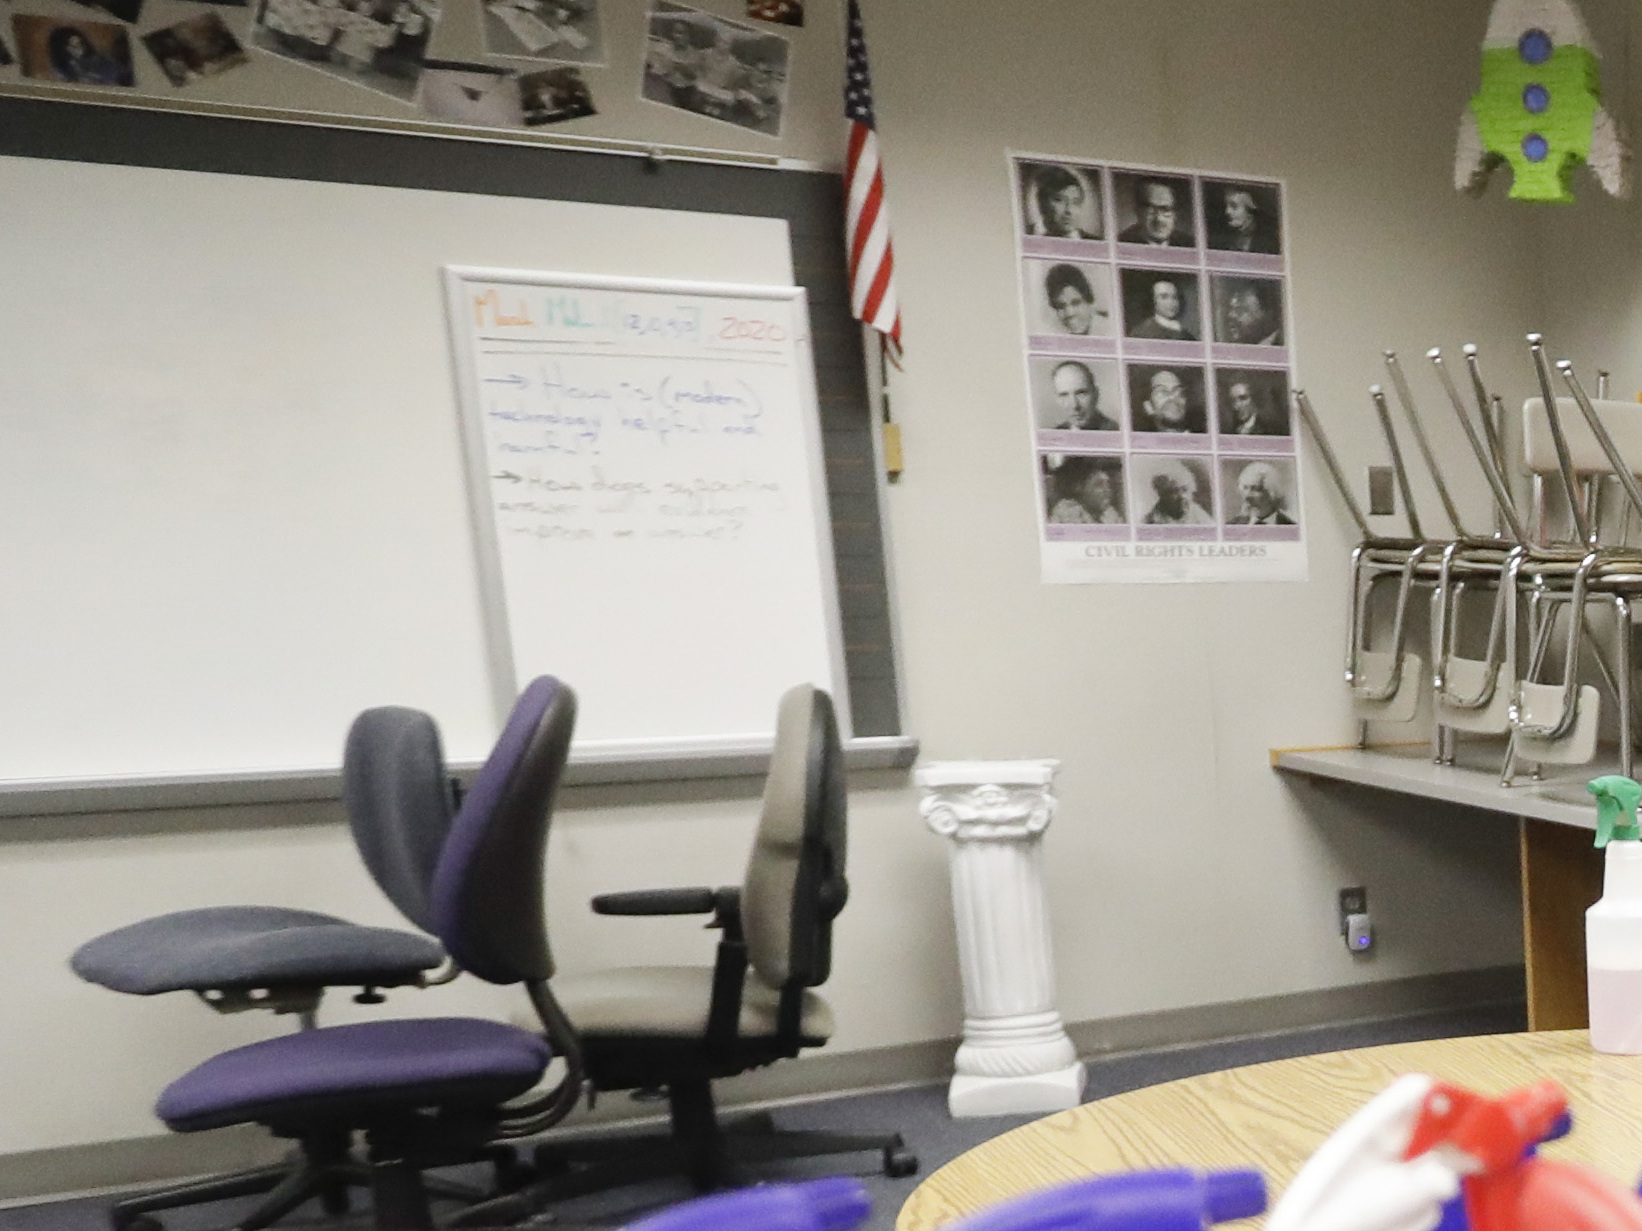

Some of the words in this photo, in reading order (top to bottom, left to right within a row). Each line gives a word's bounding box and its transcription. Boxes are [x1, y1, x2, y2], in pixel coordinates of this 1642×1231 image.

[717, 316, 787, 343] 2020
[1085, 545, 1129, 559] CIVIL
[1134, 545, 1194, 559] RIGHTS
[1198, 544, 1267, 558] LEADERS
